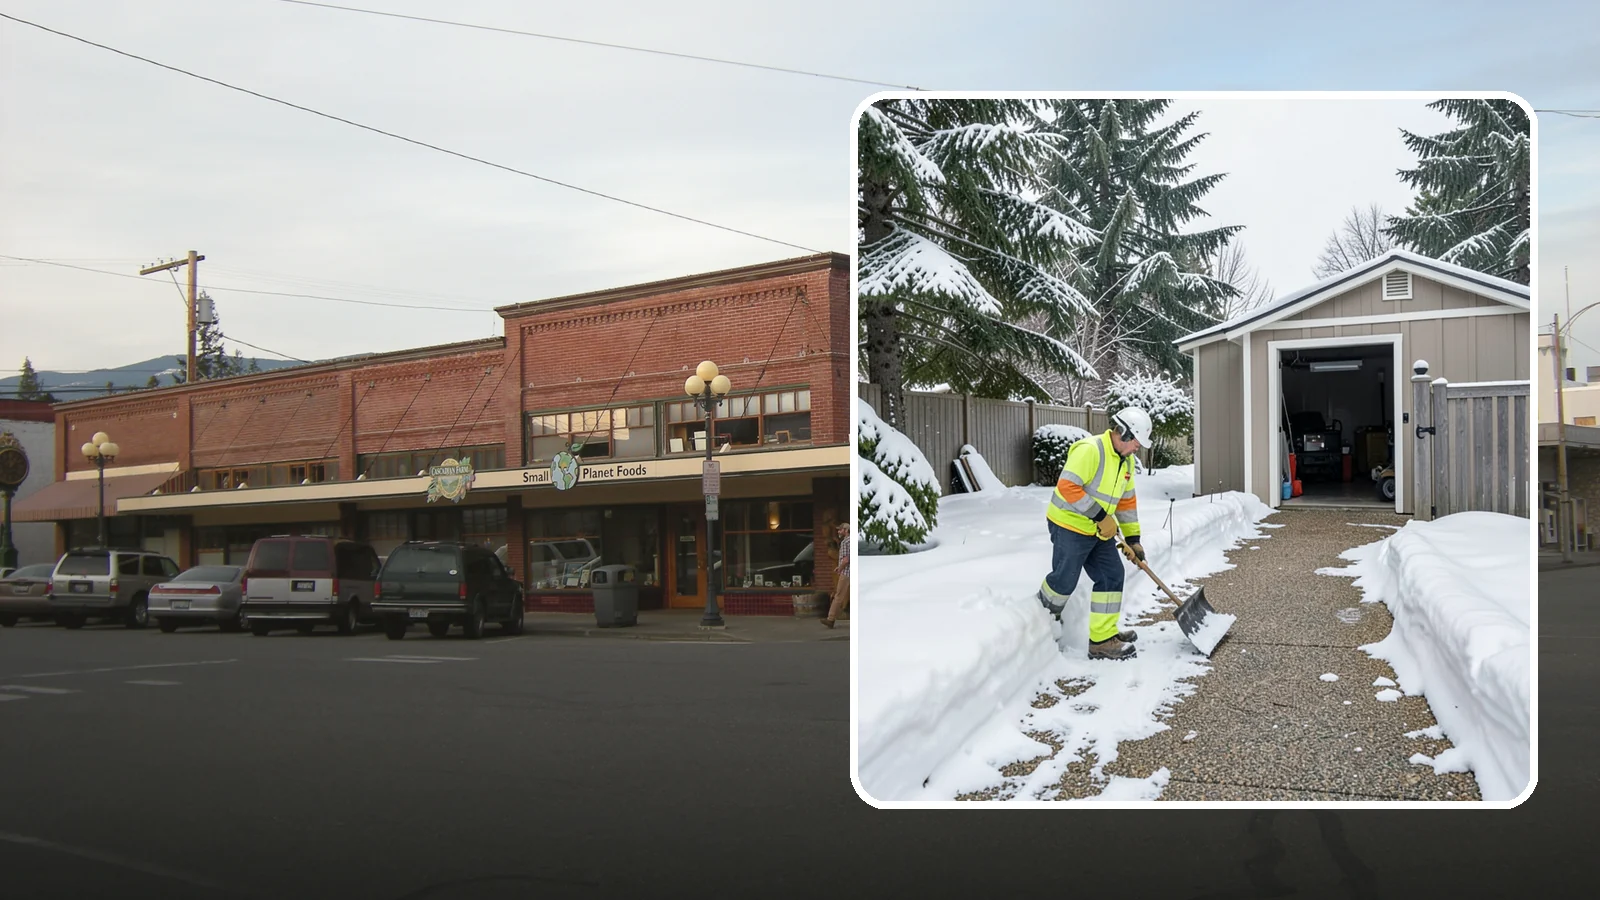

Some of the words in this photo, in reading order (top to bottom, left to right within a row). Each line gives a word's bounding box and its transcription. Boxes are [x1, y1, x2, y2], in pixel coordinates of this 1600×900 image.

[523, 470, 549, 483] Small
[583, 467, 614, 479] Planet
[617, 464, 647, 477] Foods
